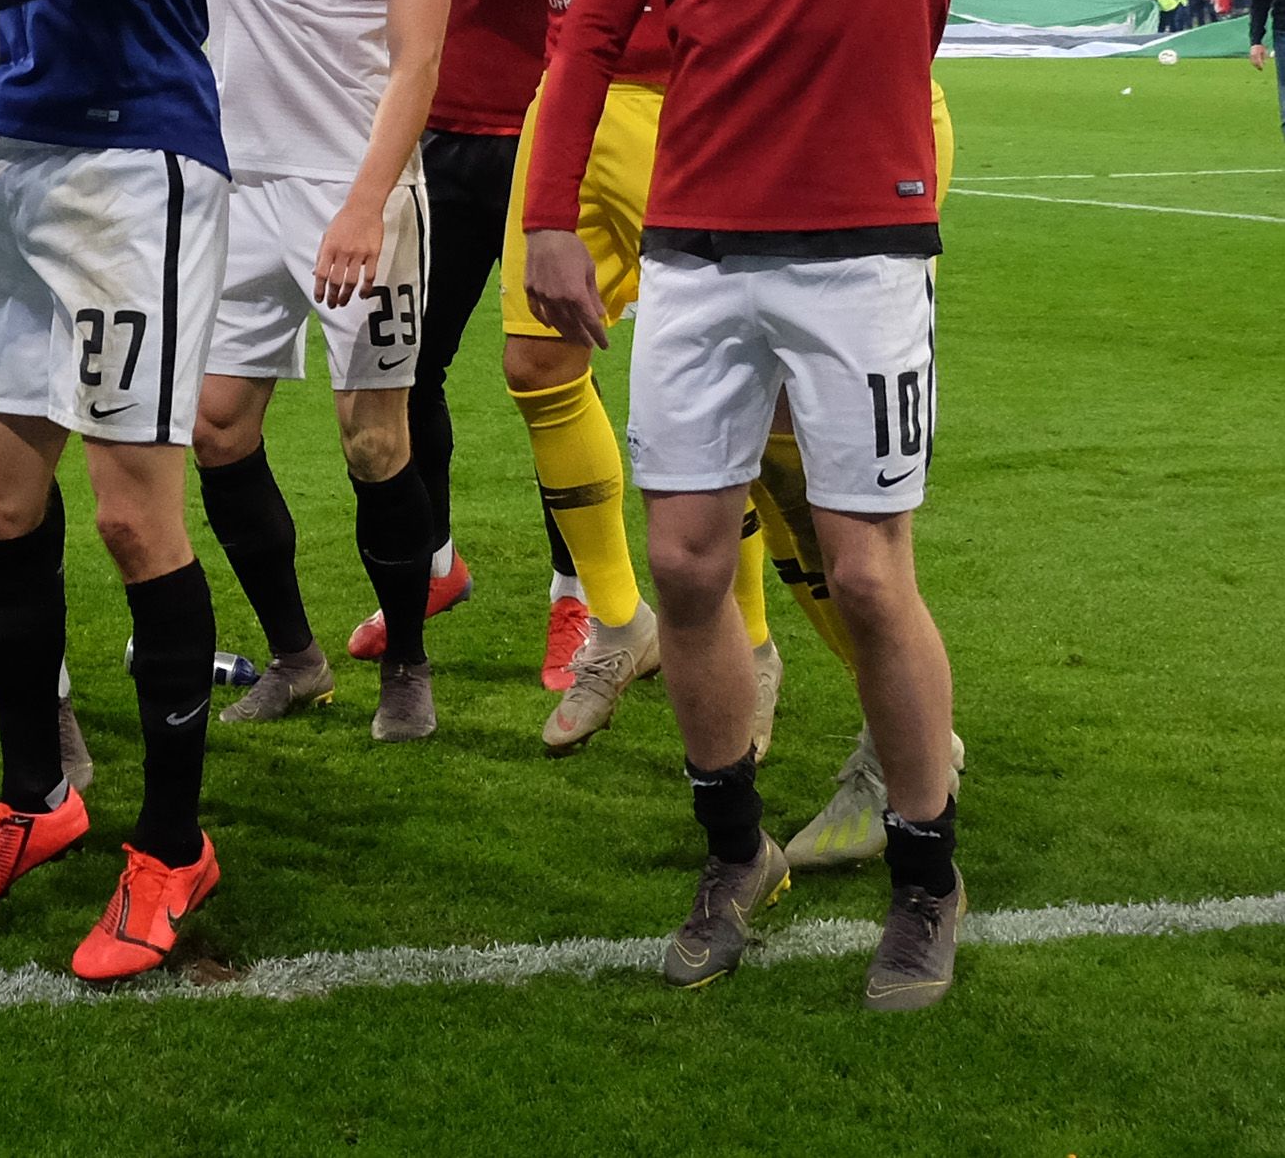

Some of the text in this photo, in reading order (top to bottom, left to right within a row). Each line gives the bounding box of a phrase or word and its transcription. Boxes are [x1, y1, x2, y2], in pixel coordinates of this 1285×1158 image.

[75, 307, 148, 391] 27
[367, 283, 417, 347] 23
[866, 370, 922, 459] 10
